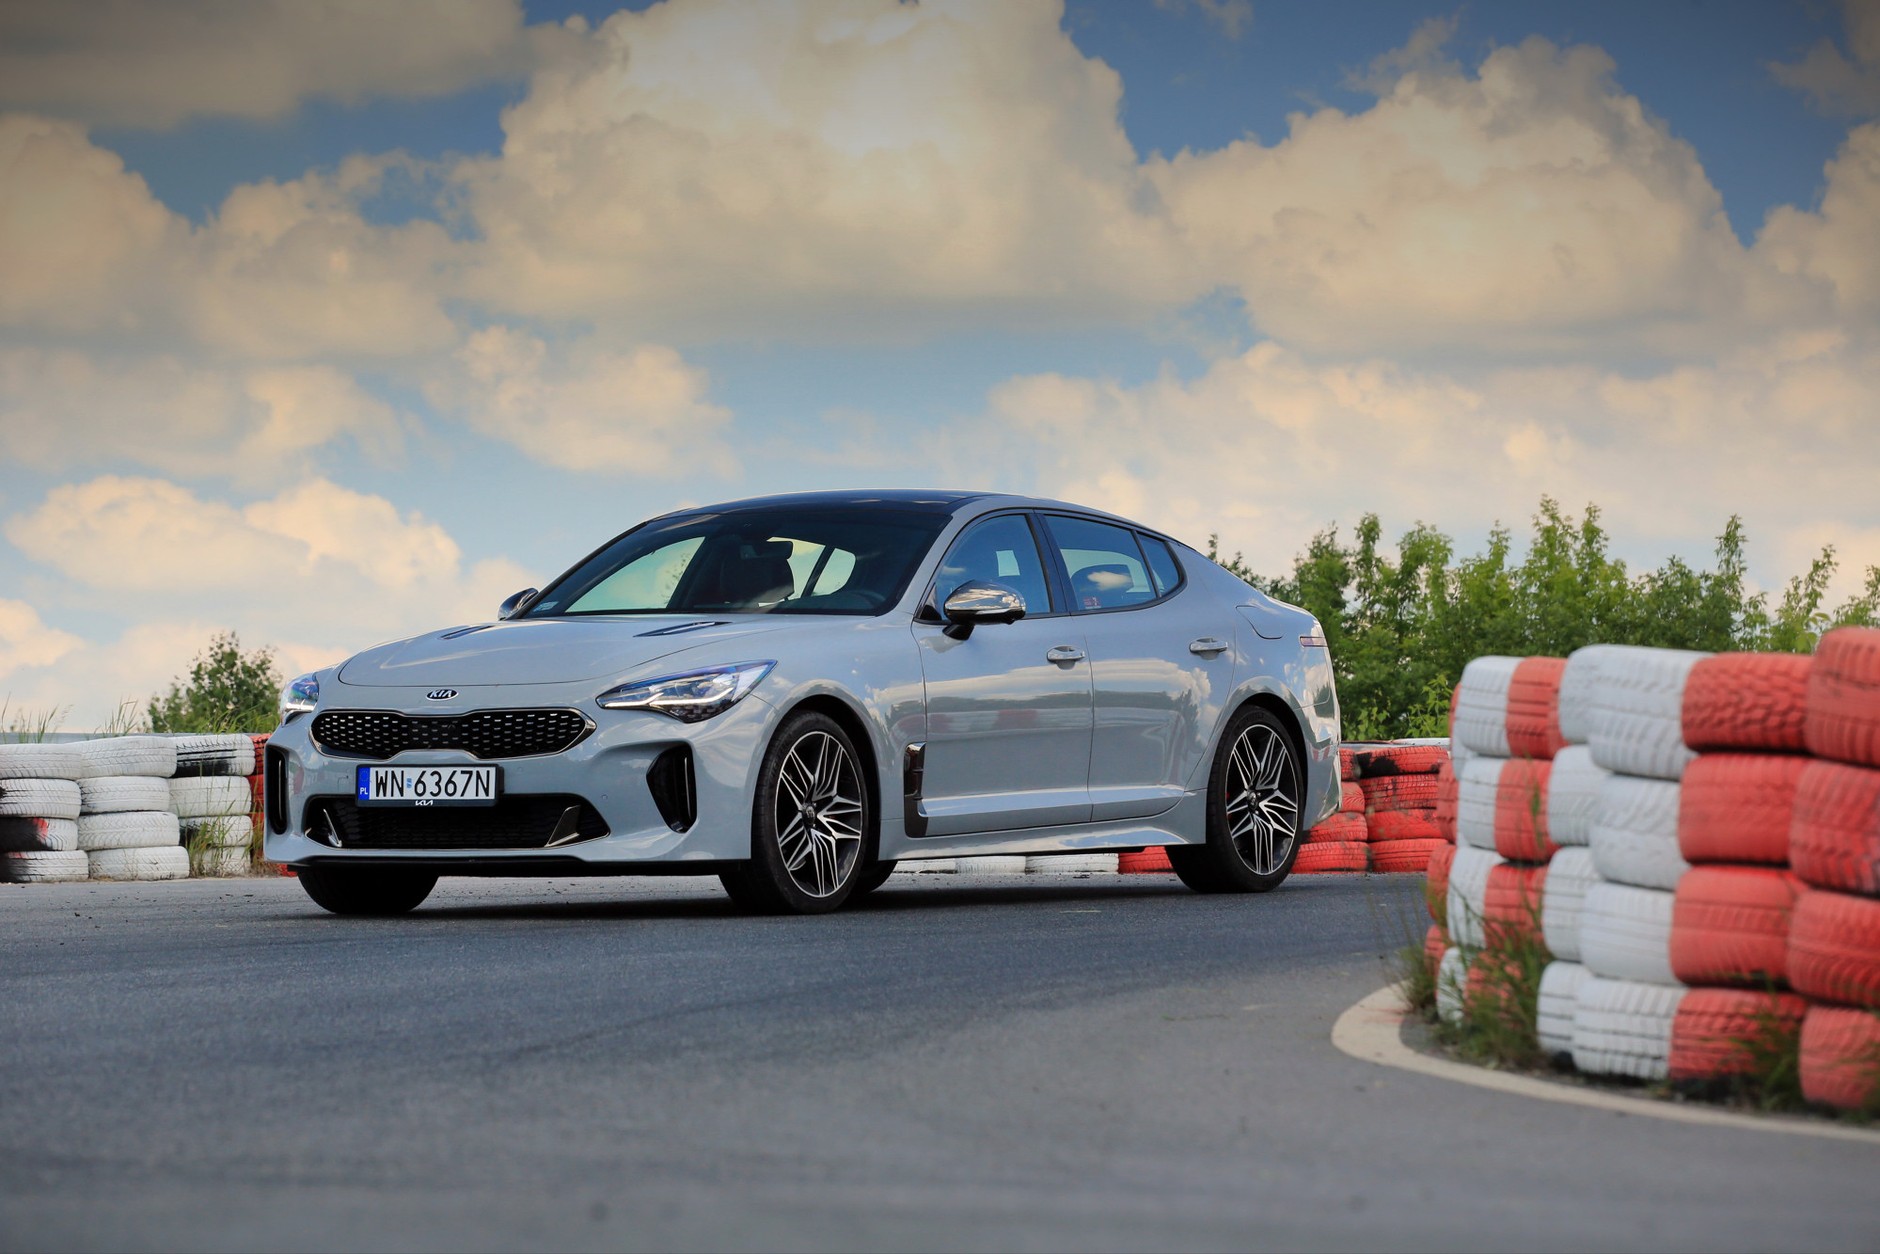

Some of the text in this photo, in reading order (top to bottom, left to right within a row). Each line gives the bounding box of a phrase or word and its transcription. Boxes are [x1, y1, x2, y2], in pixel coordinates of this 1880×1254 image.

[430, 690, 452, 698] KIA
[375, 770, 490, 797] WN 6367N
[359, 787, 368, 795] PL
